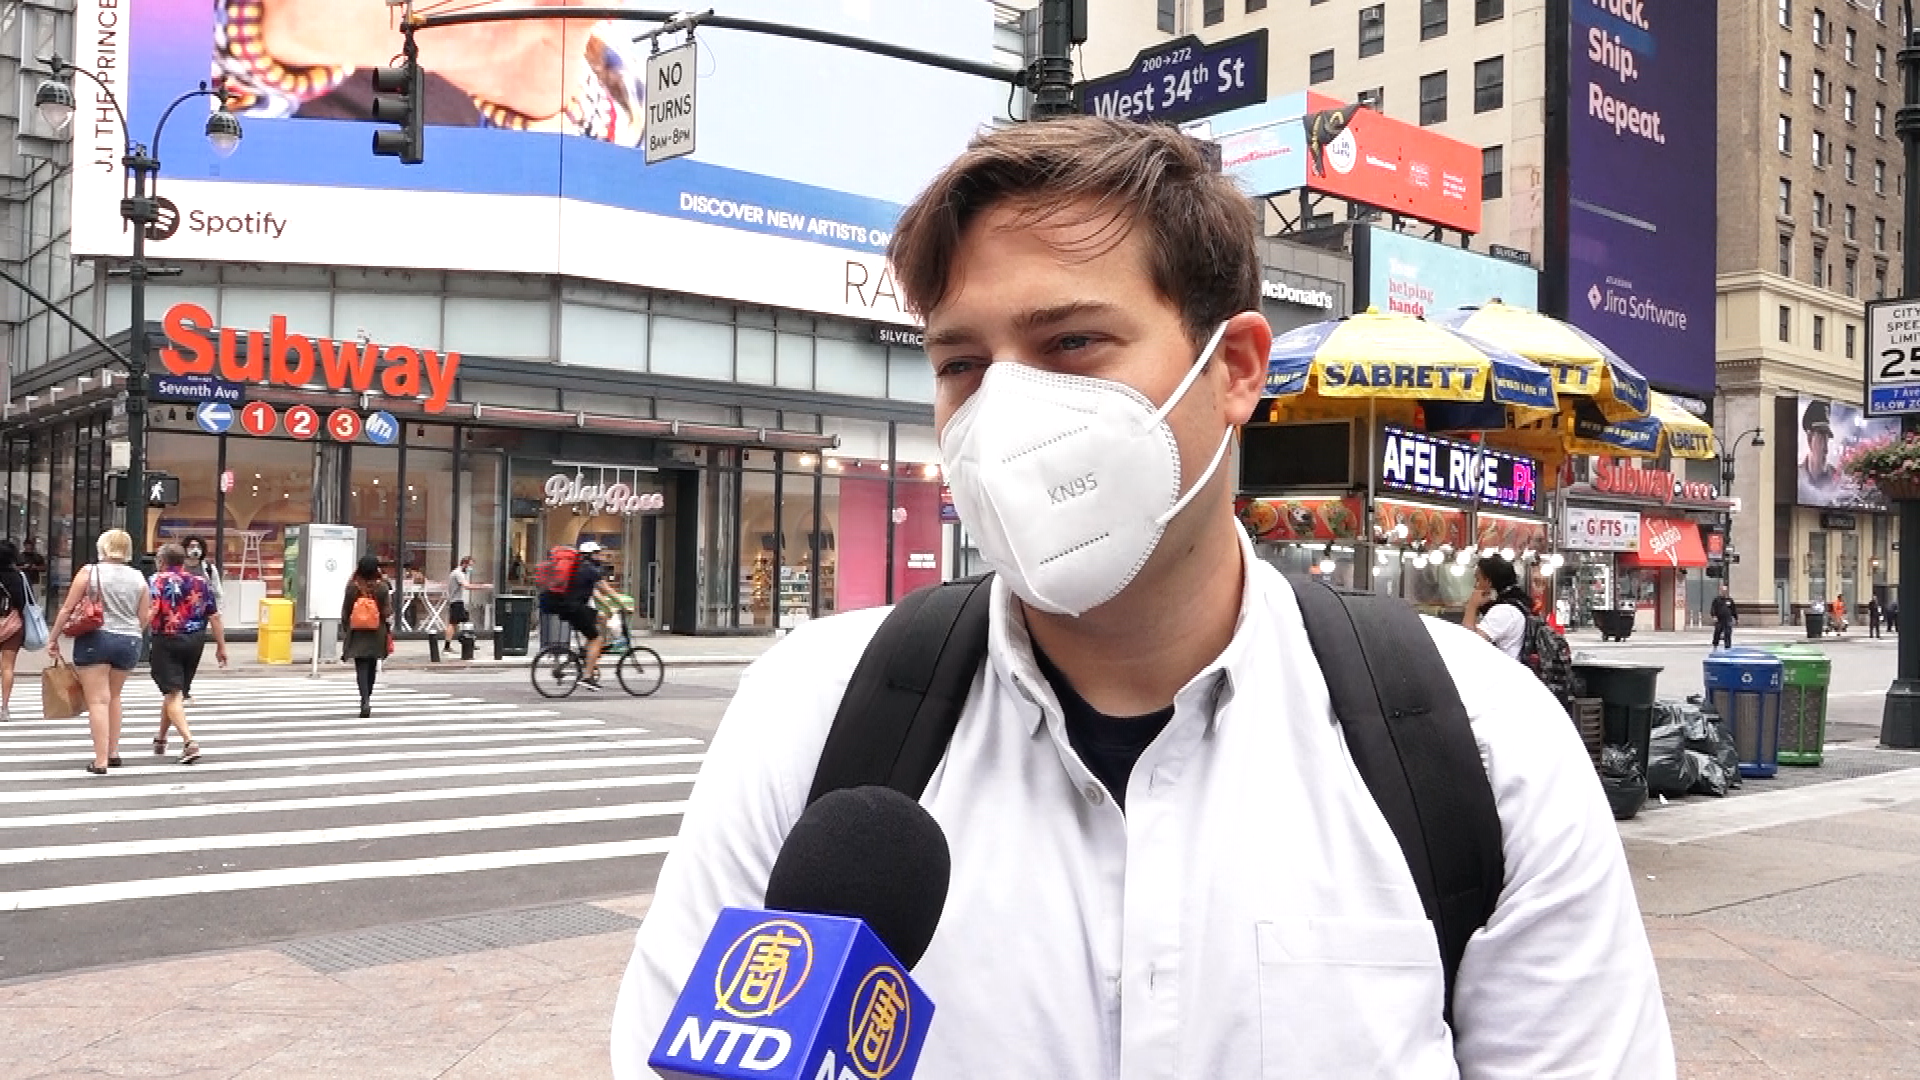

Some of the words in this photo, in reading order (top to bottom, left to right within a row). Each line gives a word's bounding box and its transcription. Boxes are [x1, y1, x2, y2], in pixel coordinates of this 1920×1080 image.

[1591, 0, 1649, 31] uck.
[1142, 57, 1163, 73] 200
[1171, 48, 1191, 65] 272
[1588, 27, 1638, 83] Ship.
[658, 61, 682, 91] NO
[1094, 82, 1155, 121] West
[1161, 62, 1209, 107] 34th
[1217, 56, 1245, 93] St
[95, 91, 115, 138] THE
[650, 94, 692, 125] TURNS
[1588, 82, 1665, 144] Repeat.
[650, 128, 690, 151] 8AM-8PM
[189, 209, 287, 239] Spotify
[680, 192, 763, 224] DISCOVER
[767, 209, 805, 231] NEW
[807, 217, 867, 243] ARTISTS
[846, 259, 909, 313] RA
[1389, 278, 1433, 305] helping
[1389, 296, 1424, 316] hands
[1604, 290, 1627, 316] Jira
[1629, 295, 1687, 331] Software
[1887, 320, 1920, 333] SPEE
[159, 301, 462, 414] Subway
[158, 381, 211, 397] Seventh
[214, 385, 239, 400] Ave
[1325, 364, 1479, 390] SABRETT
[1874, 400, 1906, 411] SLOW
[1908, 399, 1920, 410] ZO
[252, 409, 264, 430] 1
[294, 412, 310, 434] 2
[336, 413, 353, 437] 3
[366, 413, 392, 439] MTA
[1383, 435, 1445, 488] AFEL
[1449, 449, 1498, 497] RICE
[1596, 453, 1675, 505] Subway
[544, 473, 606, 516] Riley
[605, 483, 665, 515] Rose
[1047, 471, 1098, 505] KN95
[666, 1015, 792, 1071] NTD
